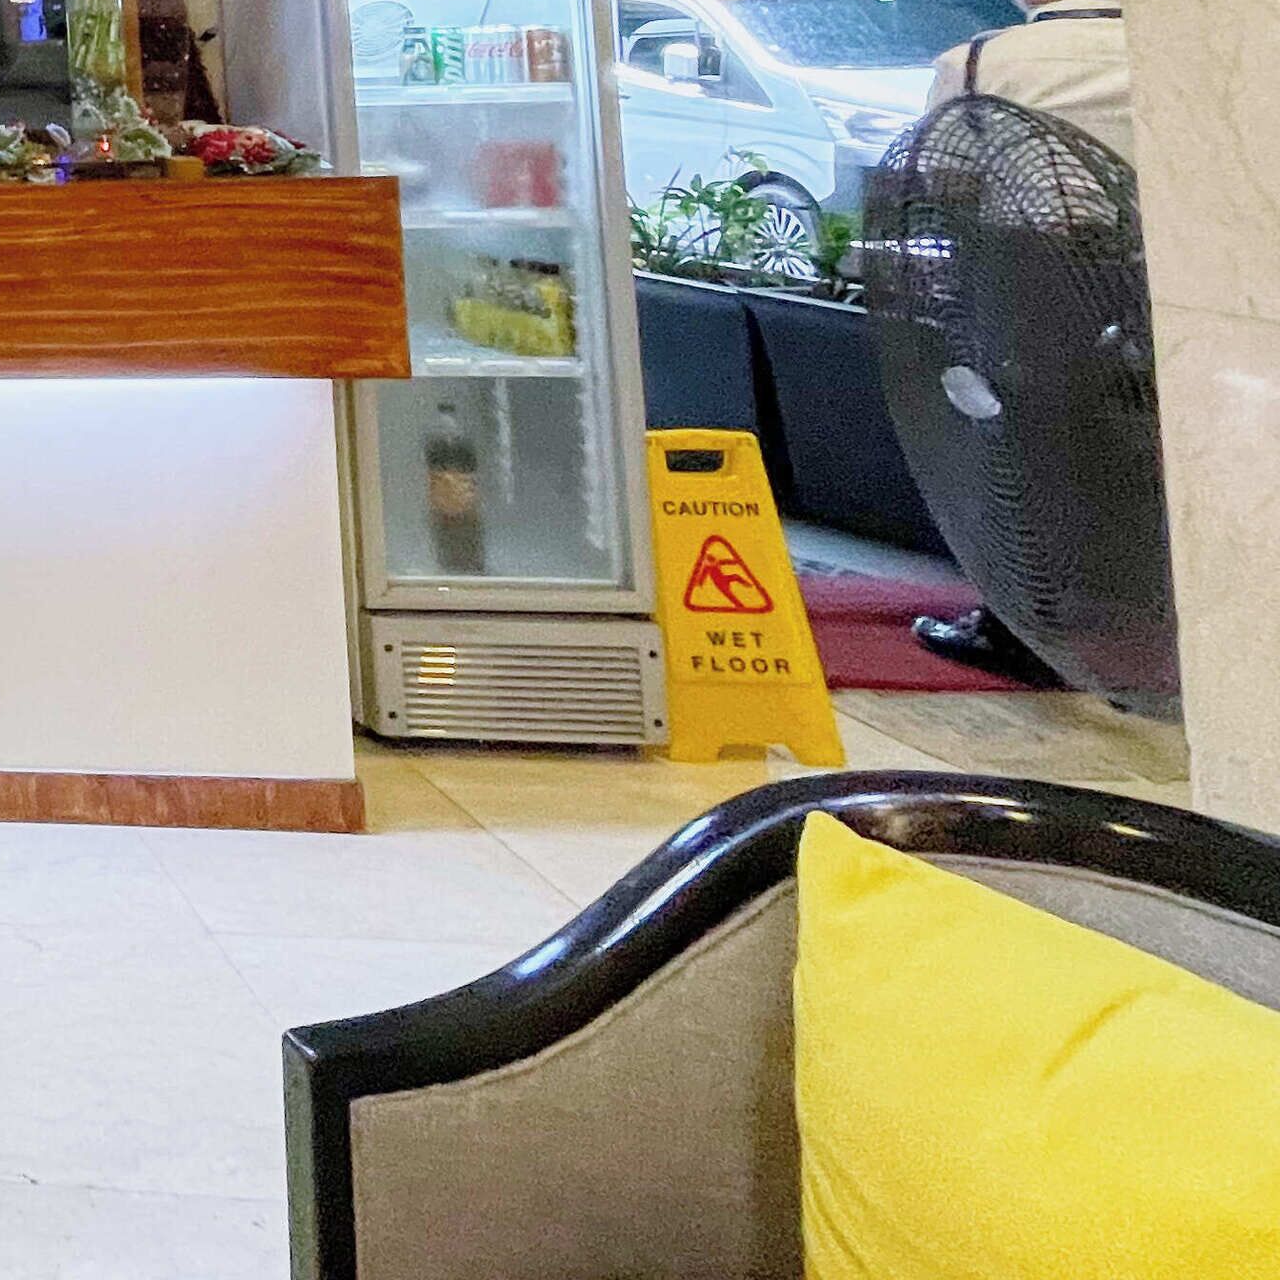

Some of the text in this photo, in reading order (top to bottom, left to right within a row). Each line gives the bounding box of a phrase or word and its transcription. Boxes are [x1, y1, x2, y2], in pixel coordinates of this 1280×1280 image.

[663, 500, 760, 517] CAUTION
[706, 631, 765, 648] WET
[690, 655, 793, 675] FLOOR
